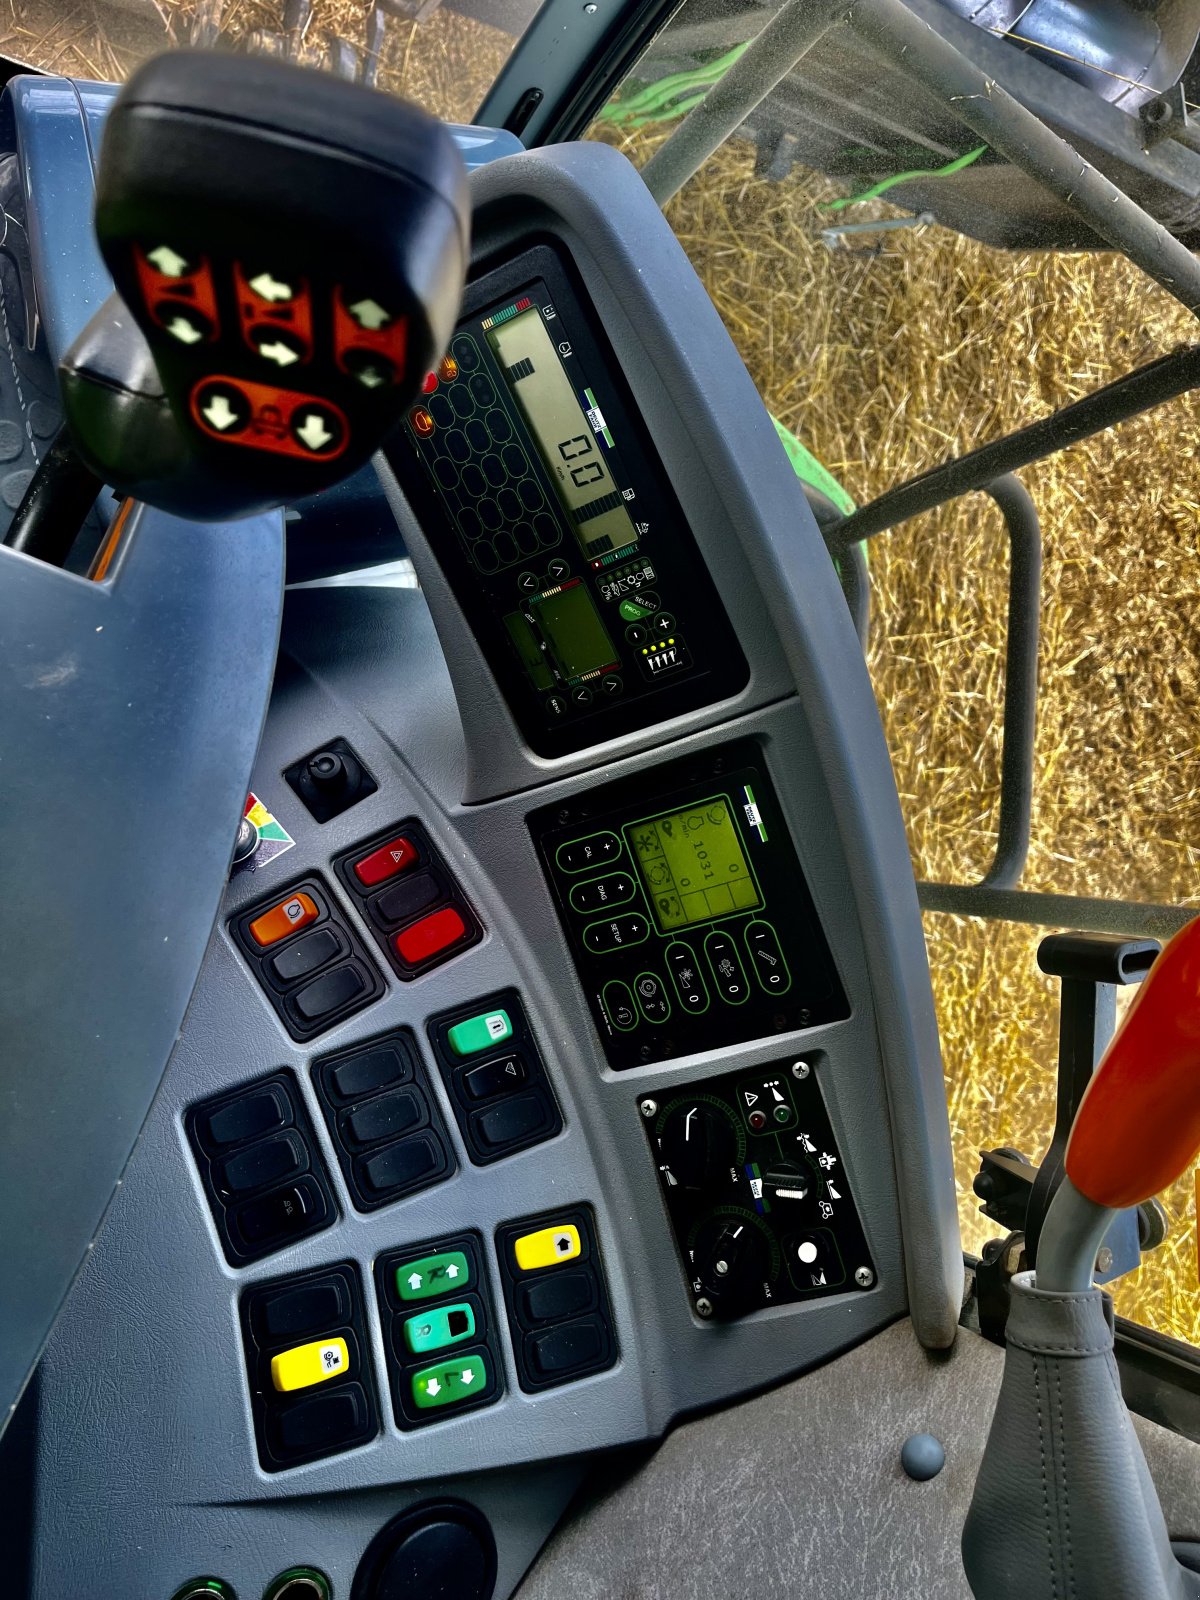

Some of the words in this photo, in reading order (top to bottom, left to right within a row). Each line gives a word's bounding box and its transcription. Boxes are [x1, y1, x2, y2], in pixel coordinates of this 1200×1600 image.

[558, 434, 605, 488] 0.0
[624, 604, 641, 616] PROG
[634, 596, 657, 609] SELECT
[550, 699, 561, 714] SENS
[584, 846, 593, 858] CAL
[693, 840, 714, 880] 1031
[728, 863, 740, 873] 0
[680, 877, 691, 887] 0
[597, 885, 608, 901] DIAG
[610, 923, 623, 943] SETUP
[729, 1167, 739, 1183] MAX
[763, 1282, 772, 1299] MAX
